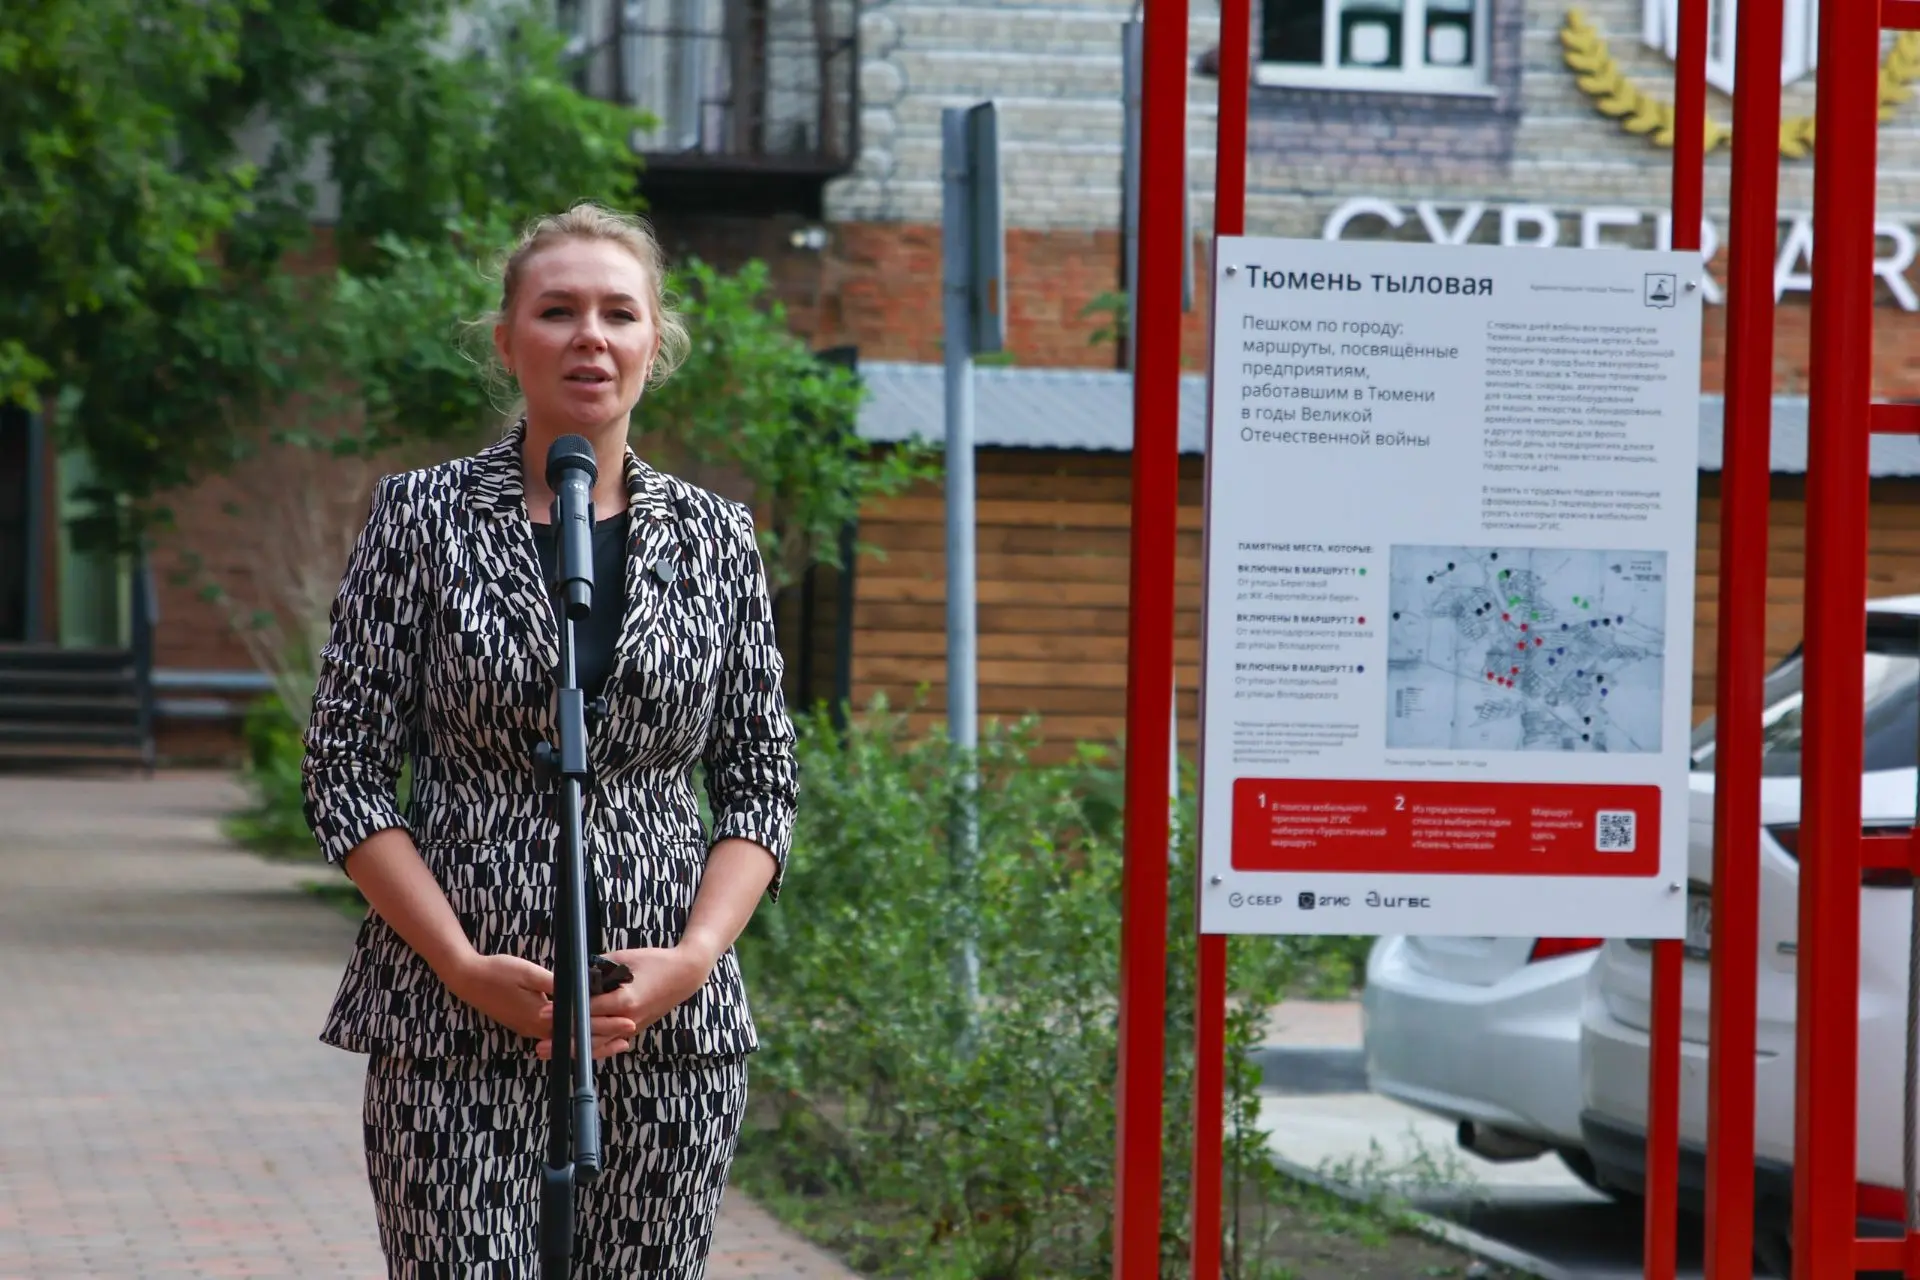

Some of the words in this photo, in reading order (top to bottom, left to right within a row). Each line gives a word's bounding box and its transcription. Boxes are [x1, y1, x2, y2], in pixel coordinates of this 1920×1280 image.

[1245, 265, 1363, 291] Тюмень
[1369, 274, 1493, 295] тыловая
[1243, 315, 1312, 331] Пешком
[1316, 321, 1338, 332] по
[1341, 322, 1404, 339] городу:
[1243, 341, 1335, 358] маршруты,
[1338, 342, 1459, 359] посвящённые
[1243, 363, 1370, 380] предприятиям,
[1241, 382, 1349, 401] работавшим
[1367, 385, 1435, 401] Тюмени
[1256, 408, 1298, 422] годы
[1301, 406, 1372, 421] Великой
[1240, 427, 1371, 444] Отечественной
[1374, 430, 1430, 445] войны
[1238, 542, 1291, 551] ПАМЯТНЫЕ
[1291, 544, 1325, 553] МЕСТА,
[1238, 565, 1293, 573] ВКЛЮЧЕНЫ
[1302, 566, 1348, 574] МАРШРУТ
[1349, 567, 1356, 575] 1
[1236, 614, 1291, 622] ВКЛЮЧЕНЫ
[1300, 615, 1347, 623] МАРШРУТ
[1235, 663, 1290, 671] ВКЛЮЧЕНЫ
[1300, 664, 1346, 672] МАРШРУТ
[1258, 793, 1266, 808] 1
[1395, 796, 1405, 811] 2
[1247, 895, 1283, 906] СБЕР
[1319, 896, 1350, 907] 2ГИС
